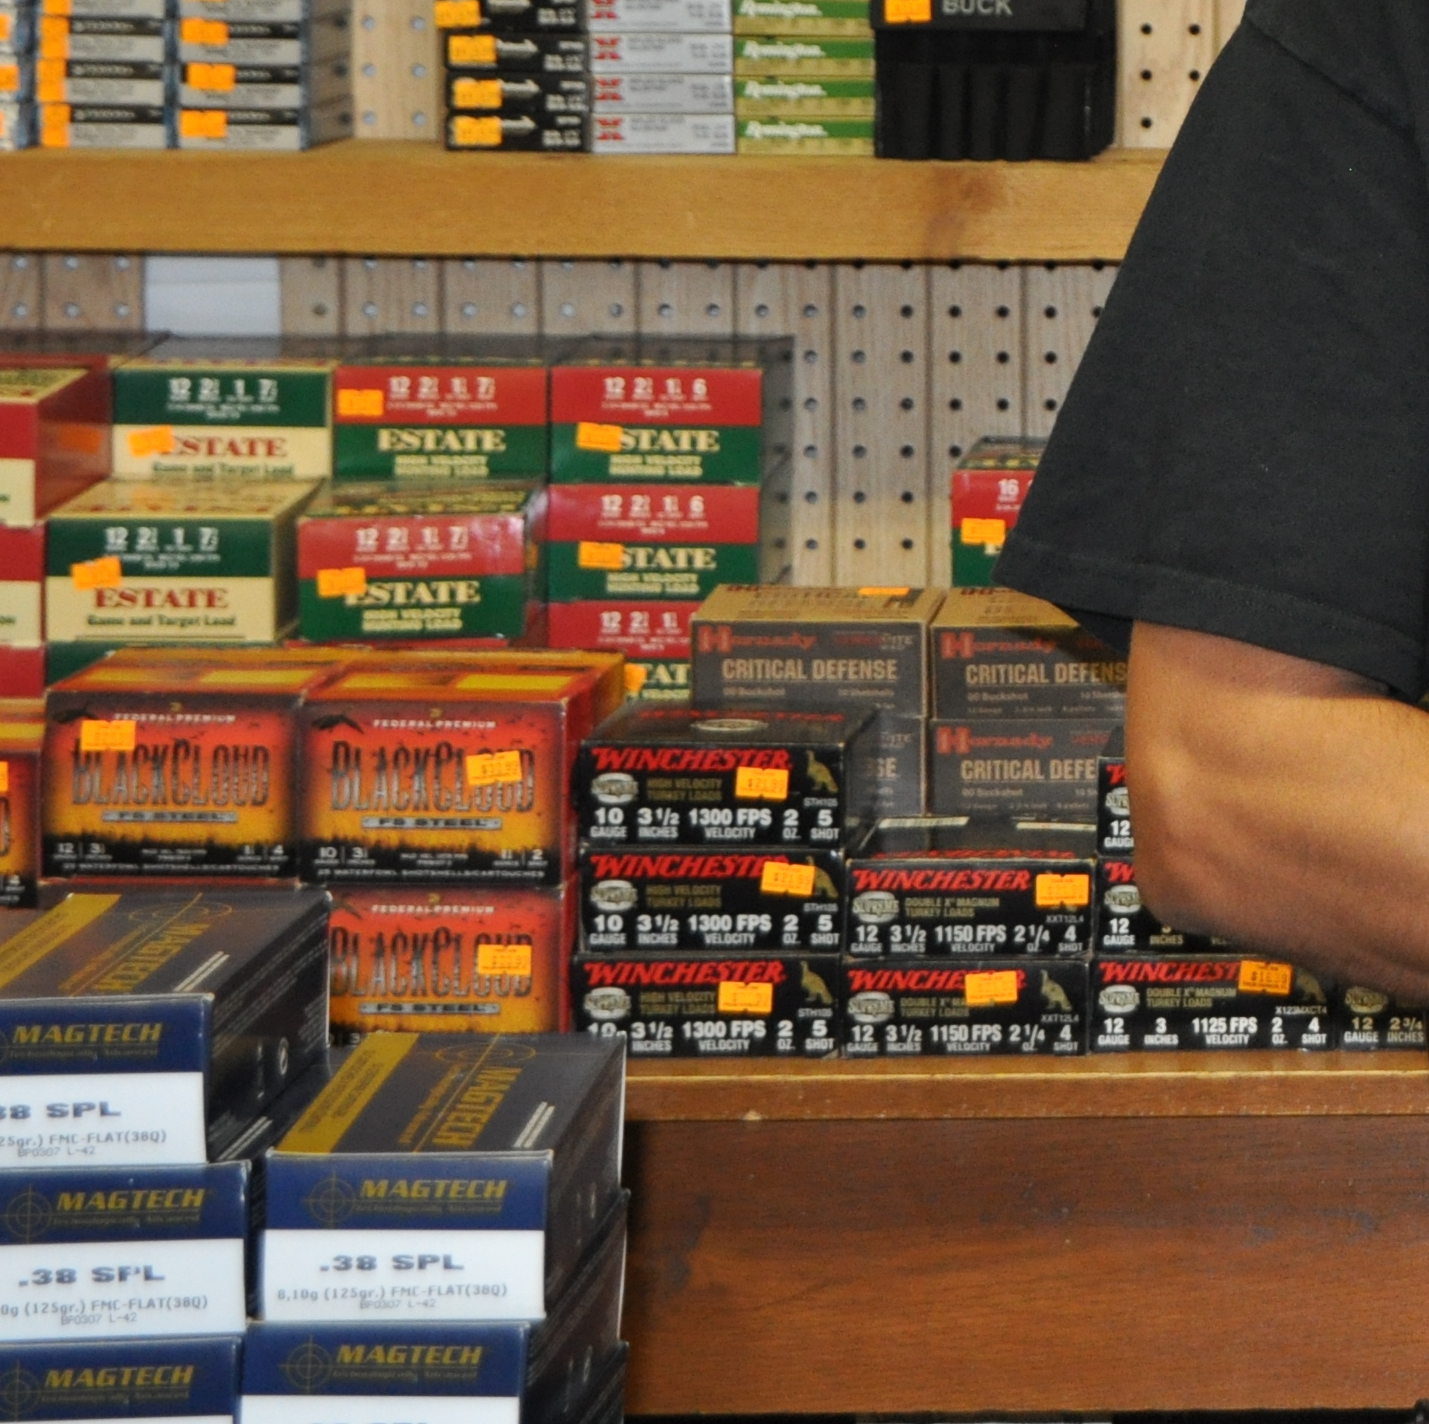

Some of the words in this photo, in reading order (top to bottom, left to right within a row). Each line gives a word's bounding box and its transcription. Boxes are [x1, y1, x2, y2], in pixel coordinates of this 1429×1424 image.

[378, 428, 506, 452] ESTATE
[95, 588, 229, 609] ESTATE
[87, 615, 124, 629] Game
[127, 615, 152, 627] and
[156, 614, 203, 629] Target
[206, 614, 236, 627] Load
[700, 625, 816, 653] Hornady
[722, 659, 806, 680] CRITICAL
[812, 659, 898, 680] DEFENSE
[374, 718, 436, 729] FEDERAL
[437, 719, 496, 730] PREMIUM
[590, 747, 791, 772] WINCHESTER
[594, 808, 623, 825] 10
[688, 808, 733, 826] 1300
[737, 808, 772, 826] FPS
[783, 808, 799, 826] 2
[817, 809, 833, 826] 5
[589, 827, 628, 839] GAUGE
[638, 827, 679, 839] INCHES
[704, 827, 756, 840] VELOCITY
[810, 827, 840, 840] SHOT
[12, 1022, 163, 1046] MAGTECH
[359, 1179, 510, 1200] MAGTECH
[56, 1188, 207, 1213] MAGTECH
[319, 1255, 378, 1271] .38
[392, 1254, 465, 1271] SPL
[18, 1267, 77, 1287] .38
[92, 1264, 166, 1284] SPL
[323, 1286, 386, 1302] (125gr.)
[390, 1283, 509, 1299] FMC-FLAT(38Q)
